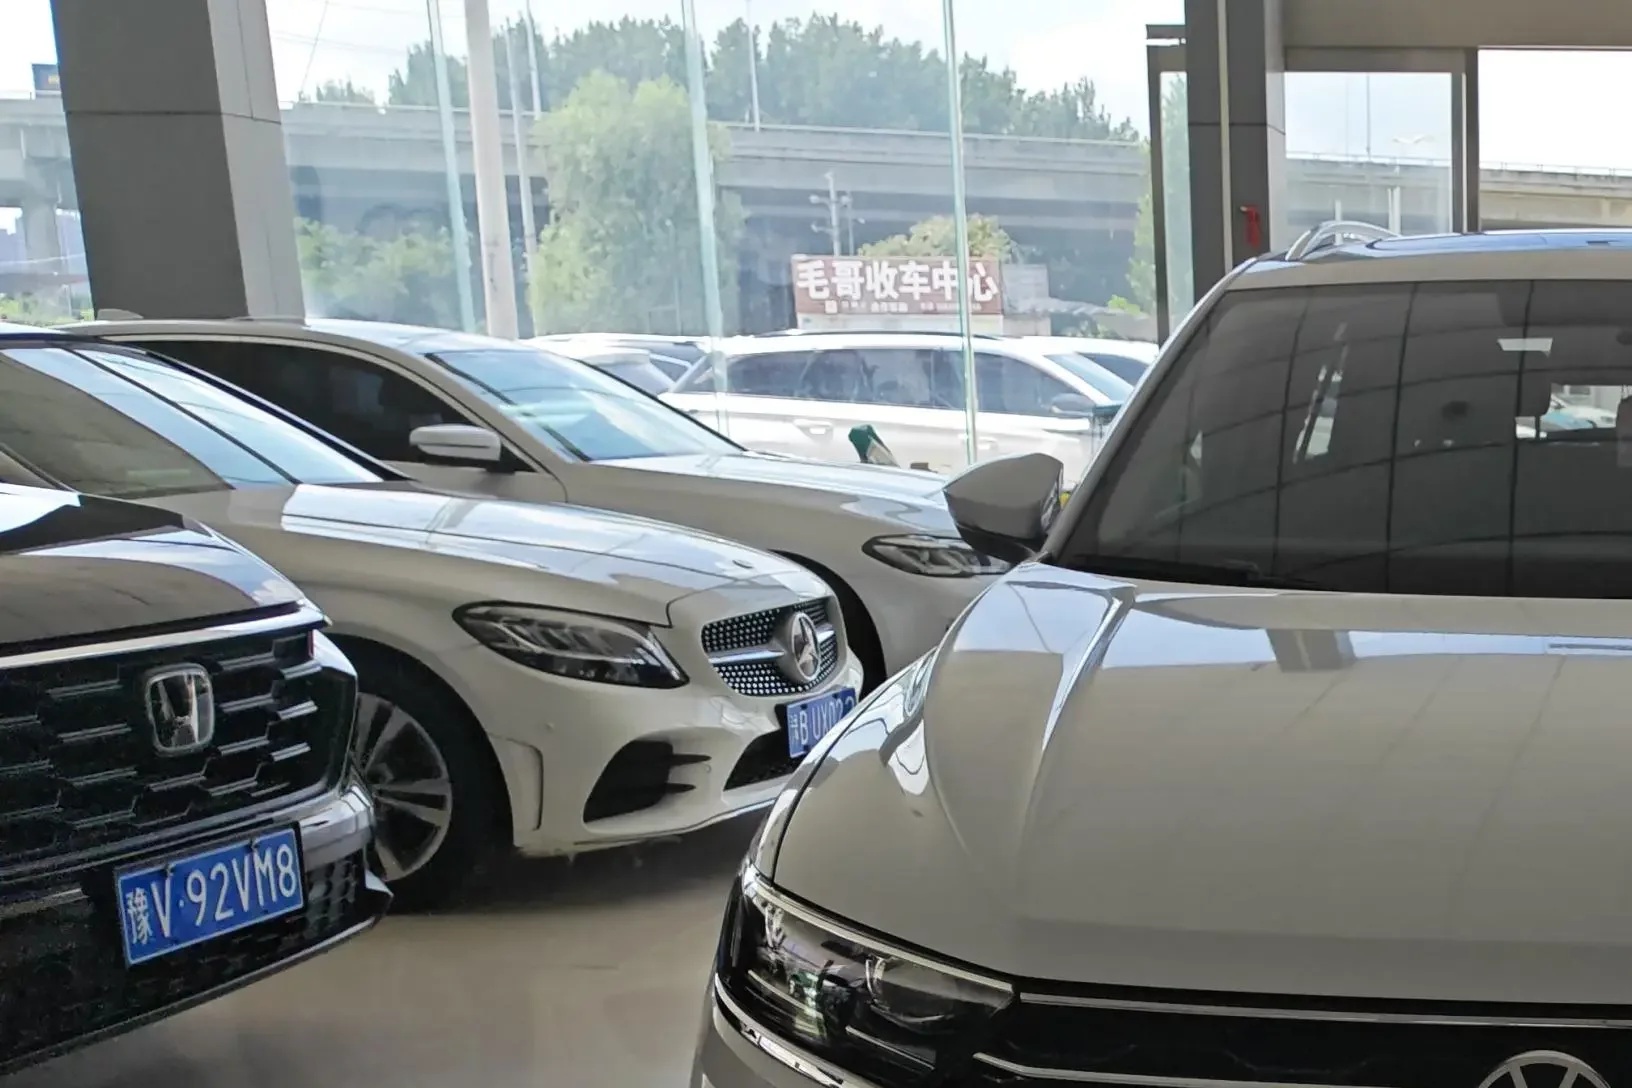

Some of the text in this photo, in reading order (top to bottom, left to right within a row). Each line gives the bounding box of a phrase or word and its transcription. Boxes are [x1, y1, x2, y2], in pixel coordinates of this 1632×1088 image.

[796, 259, 999, 302] 毛哥收车中心
[125, 843, 297, 945] 豫V·92VM8
